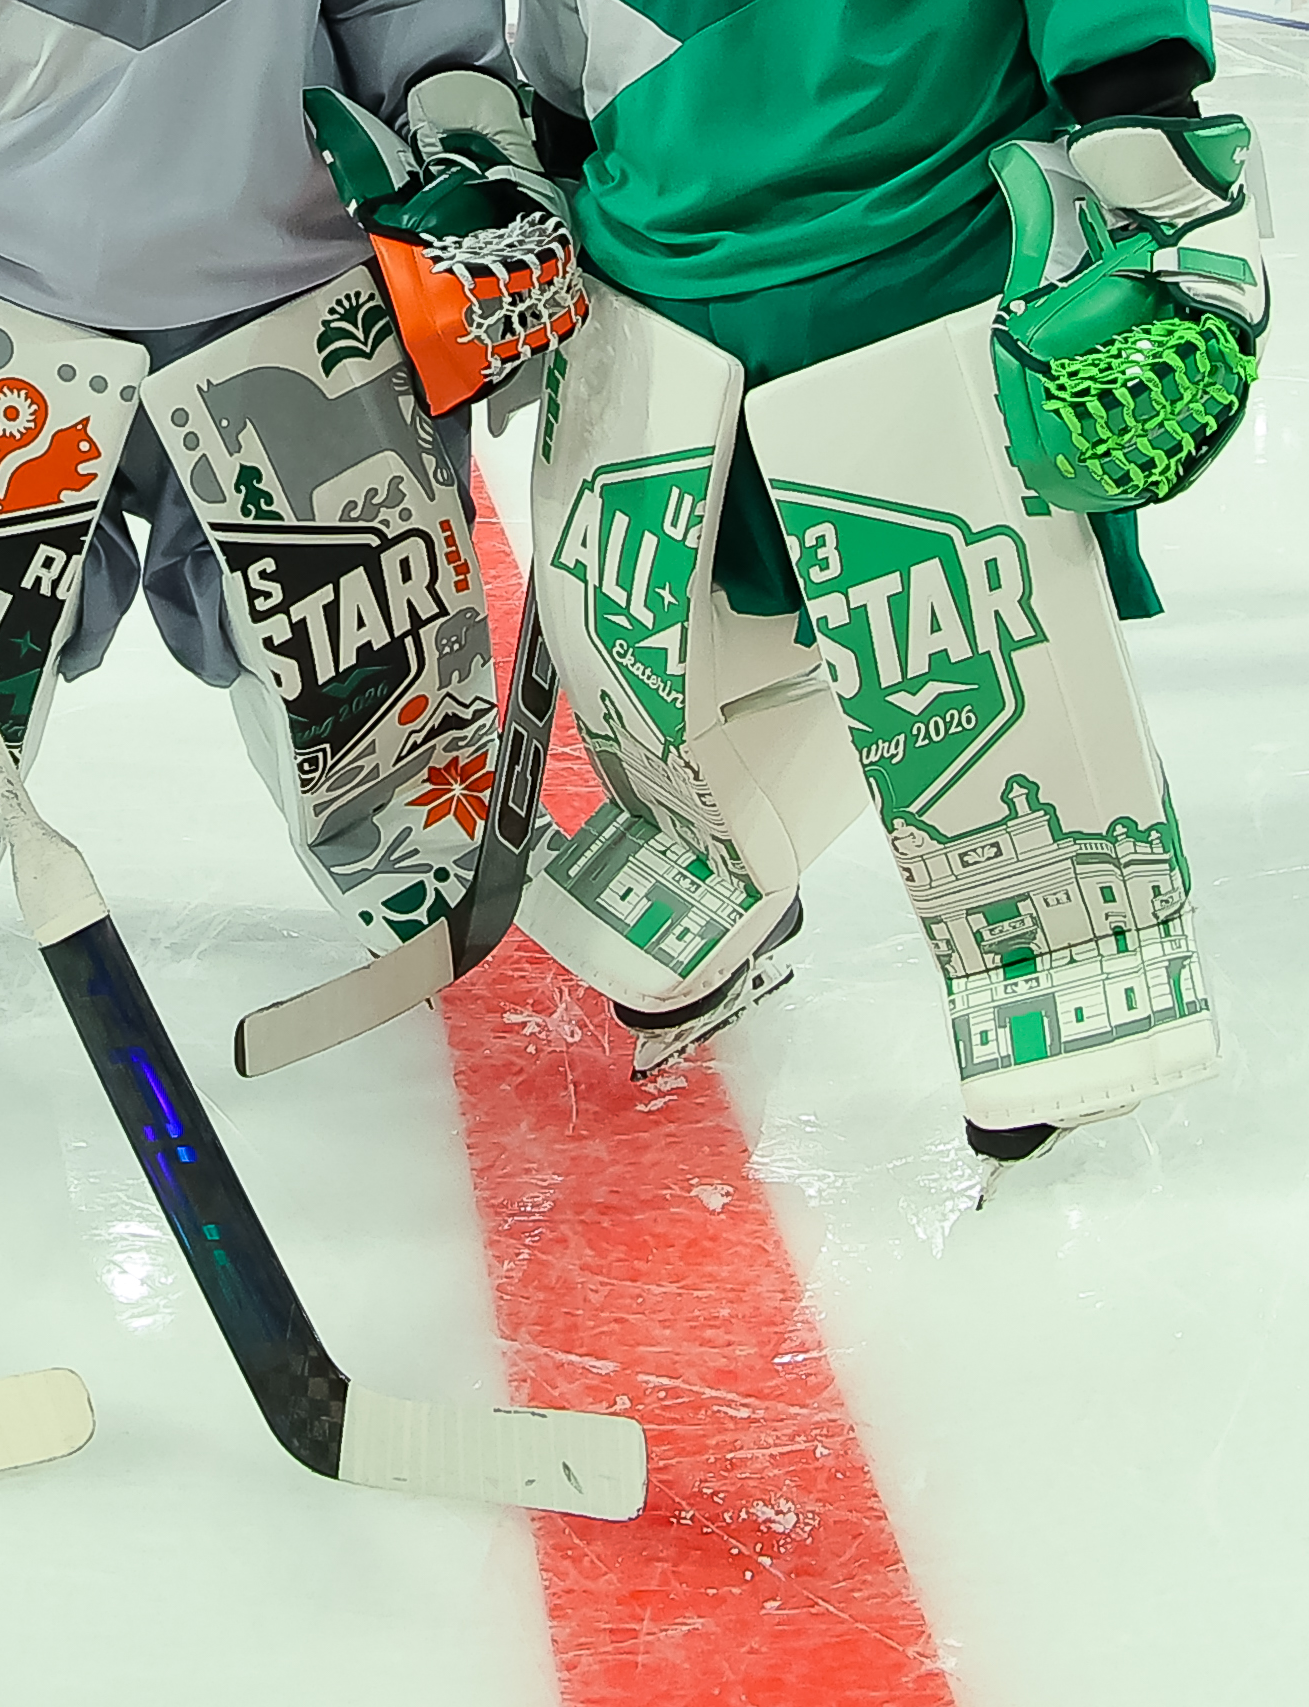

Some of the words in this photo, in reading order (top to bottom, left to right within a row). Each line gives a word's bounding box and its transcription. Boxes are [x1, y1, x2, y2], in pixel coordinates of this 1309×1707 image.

[248, 556, 280, 612] S
[263, 537, 436, 702] STAR
[558, 489, 659, 631] ALL
[813, 532, 1037, 702] STAR
[612, 639, 686, 709] Ekaterin
[911, 702, 978, 751] 2026
